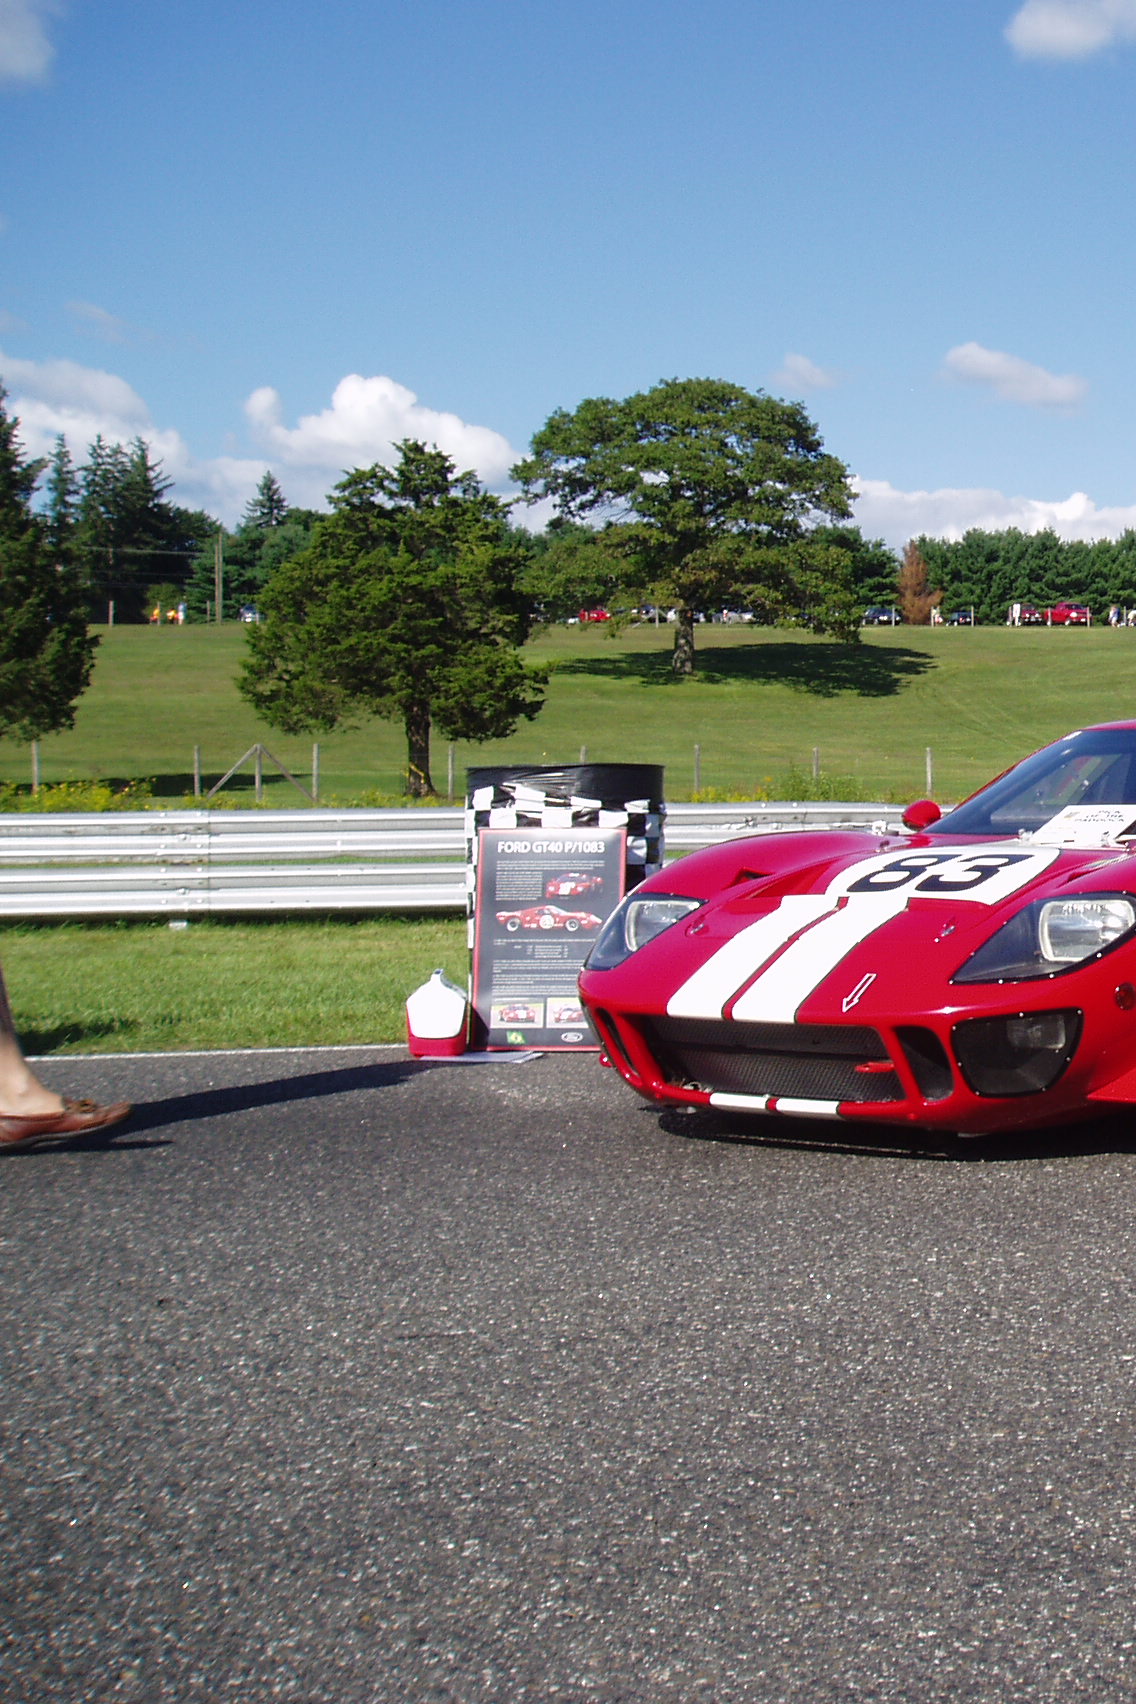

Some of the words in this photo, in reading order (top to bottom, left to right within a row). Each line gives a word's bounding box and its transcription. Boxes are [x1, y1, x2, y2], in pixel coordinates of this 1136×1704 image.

[497, 841, 530, 853] FORD
[532, 841, 562, 853] GT40
[564, 841, 605, 853] P/1083
[847, 853, 1034, 892] 83
